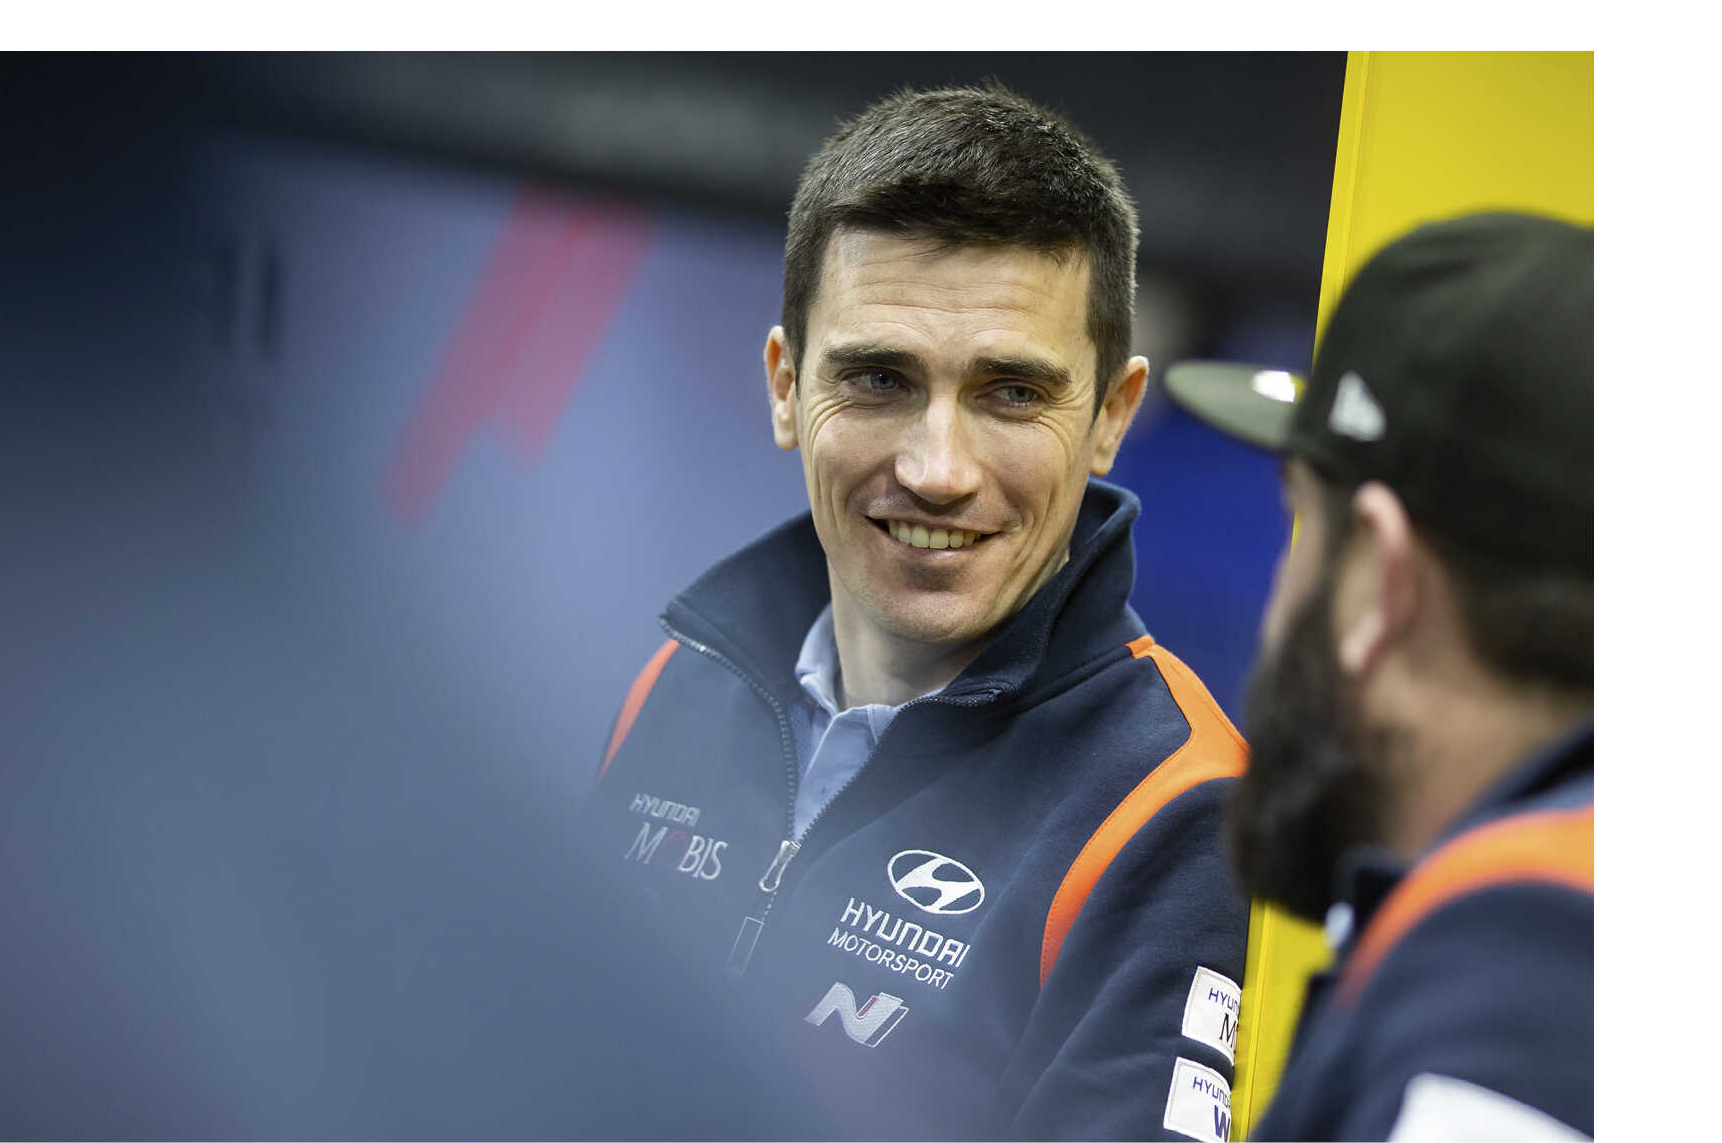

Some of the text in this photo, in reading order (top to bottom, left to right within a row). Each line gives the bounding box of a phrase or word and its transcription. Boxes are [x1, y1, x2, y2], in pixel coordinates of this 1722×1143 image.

[629, 792, 702, 829] HYUNDAI
[623, 821, 729, 881] MOBIS
[840, 897, 971, 968] HYUNDAI
[827, 927, 955, 990] MOTORSPORT
[1208, 987, 1240, 1014] HYUN
[1218, 1012, 1239, 1049] M
